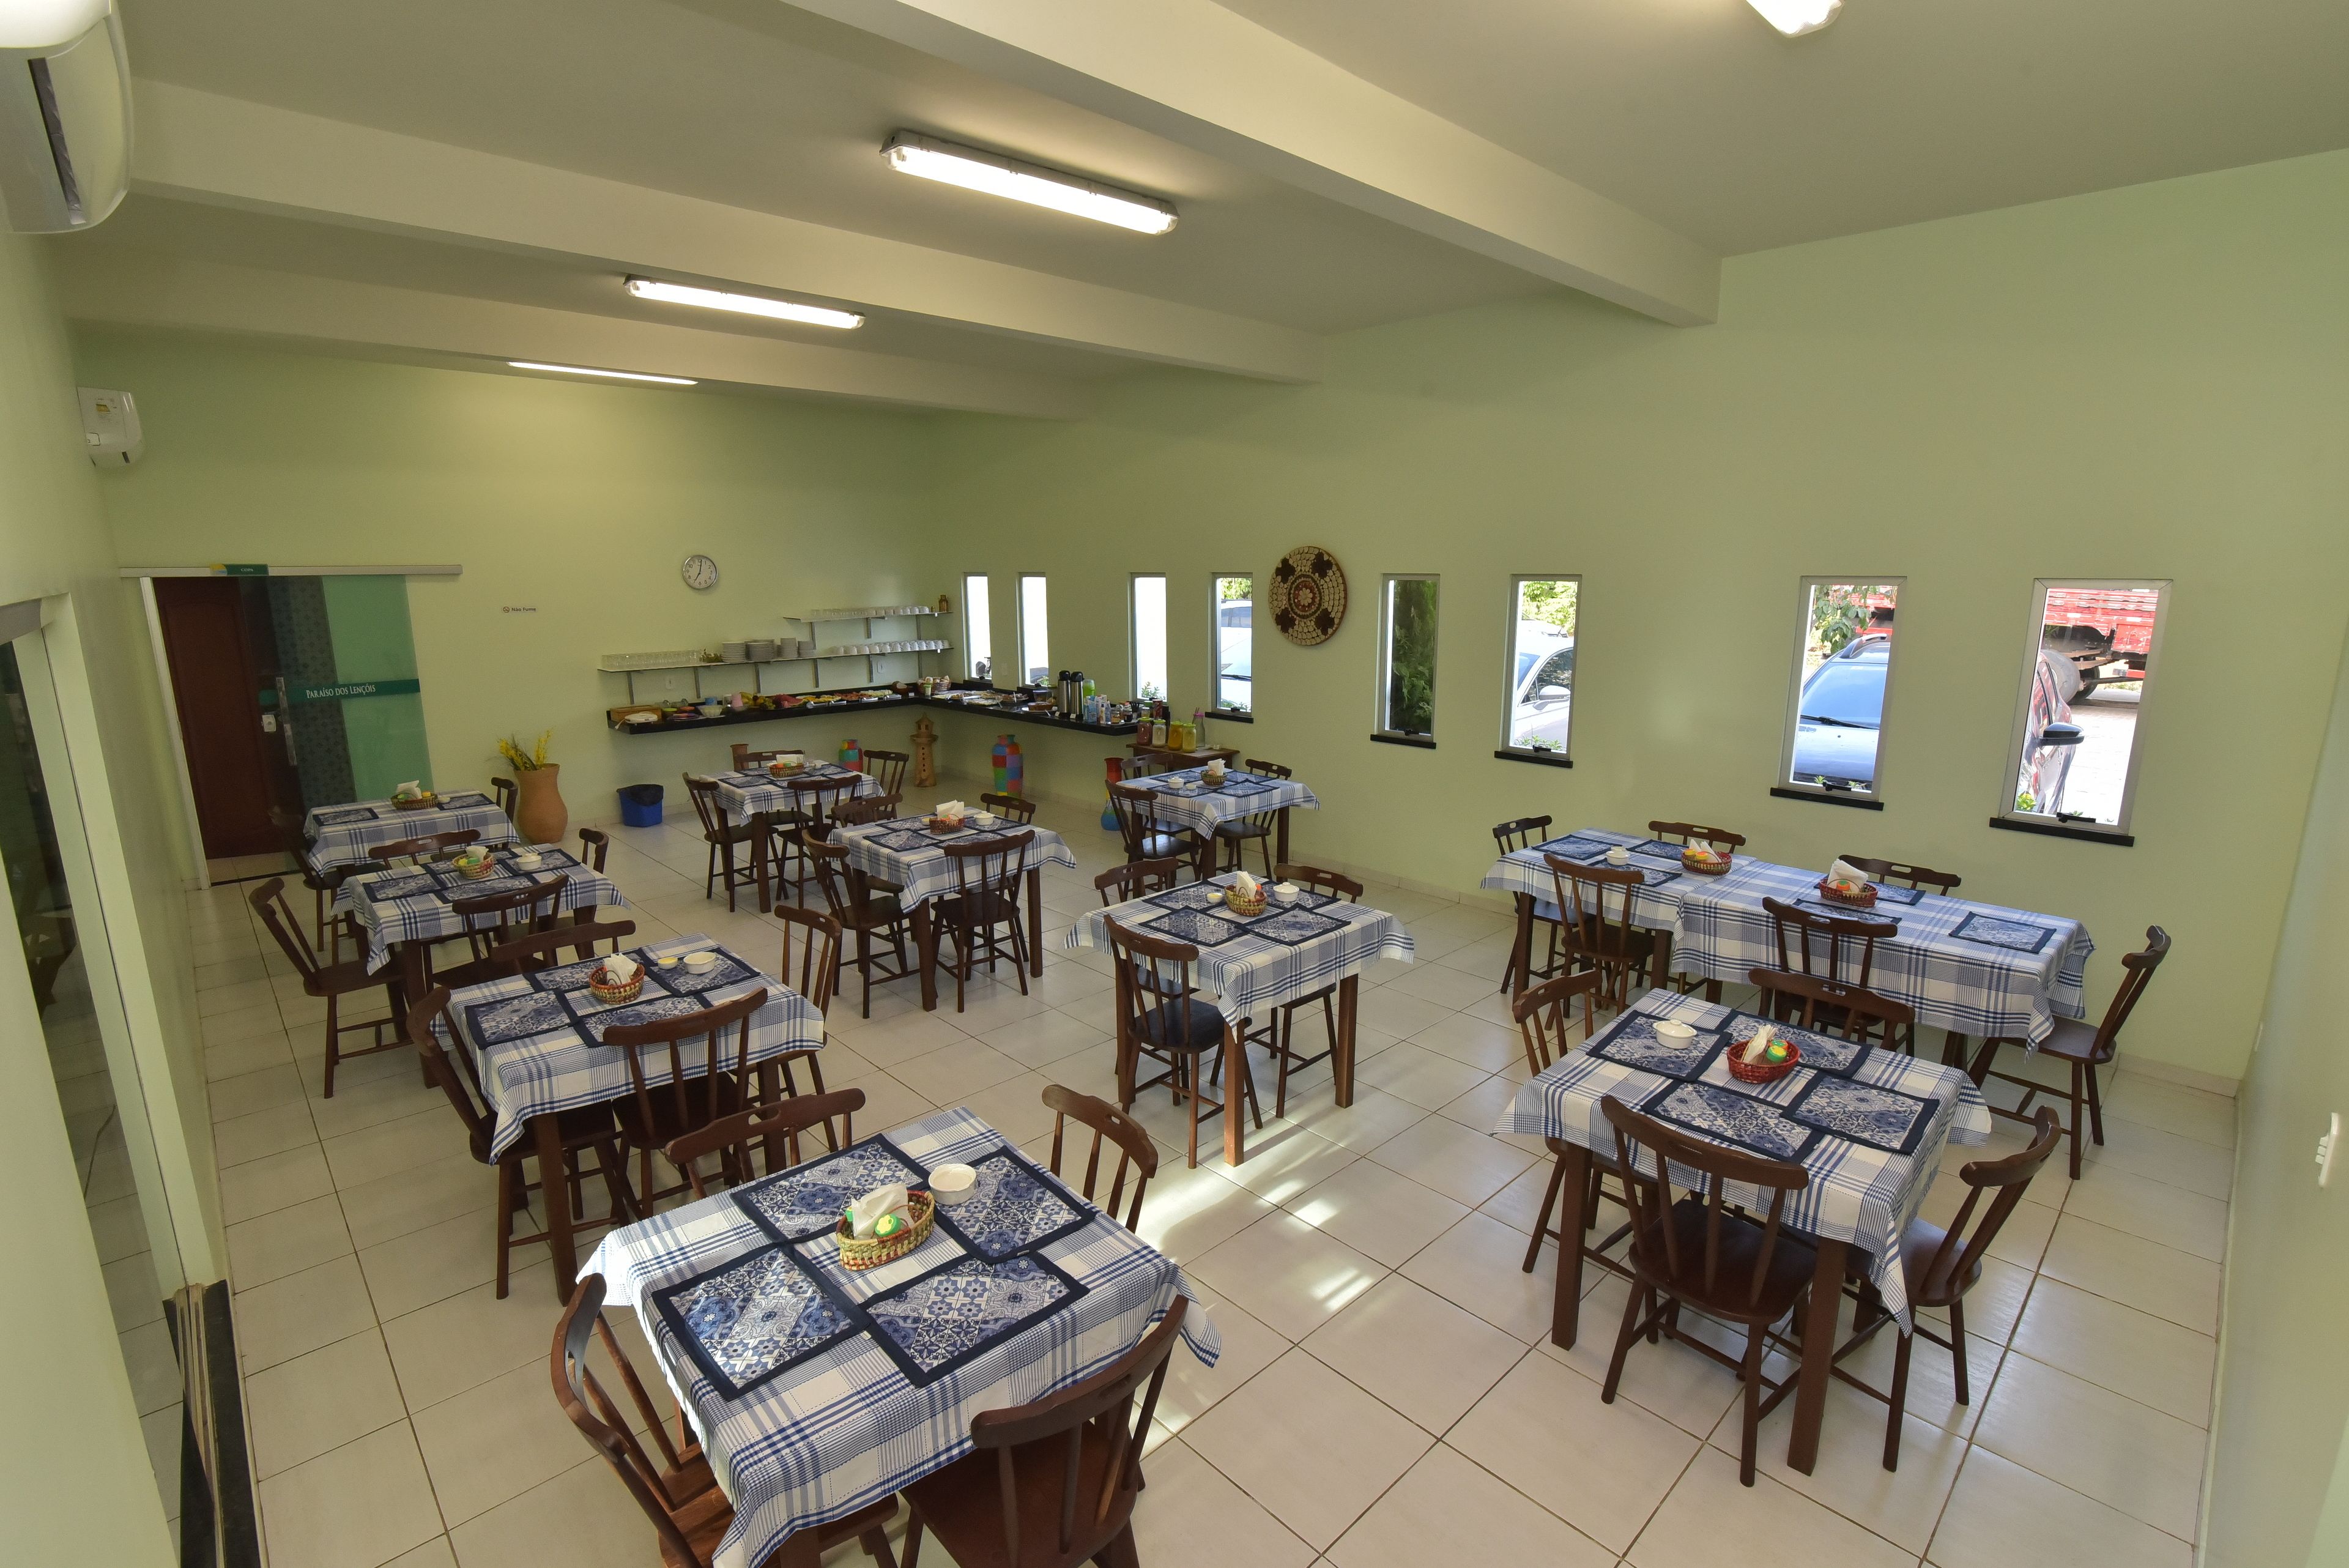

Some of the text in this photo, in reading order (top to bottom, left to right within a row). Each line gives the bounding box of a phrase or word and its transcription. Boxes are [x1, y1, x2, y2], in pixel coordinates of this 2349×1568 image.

[306, 683, 376, 699] PARAÍSO DOS LENÇÓIS
